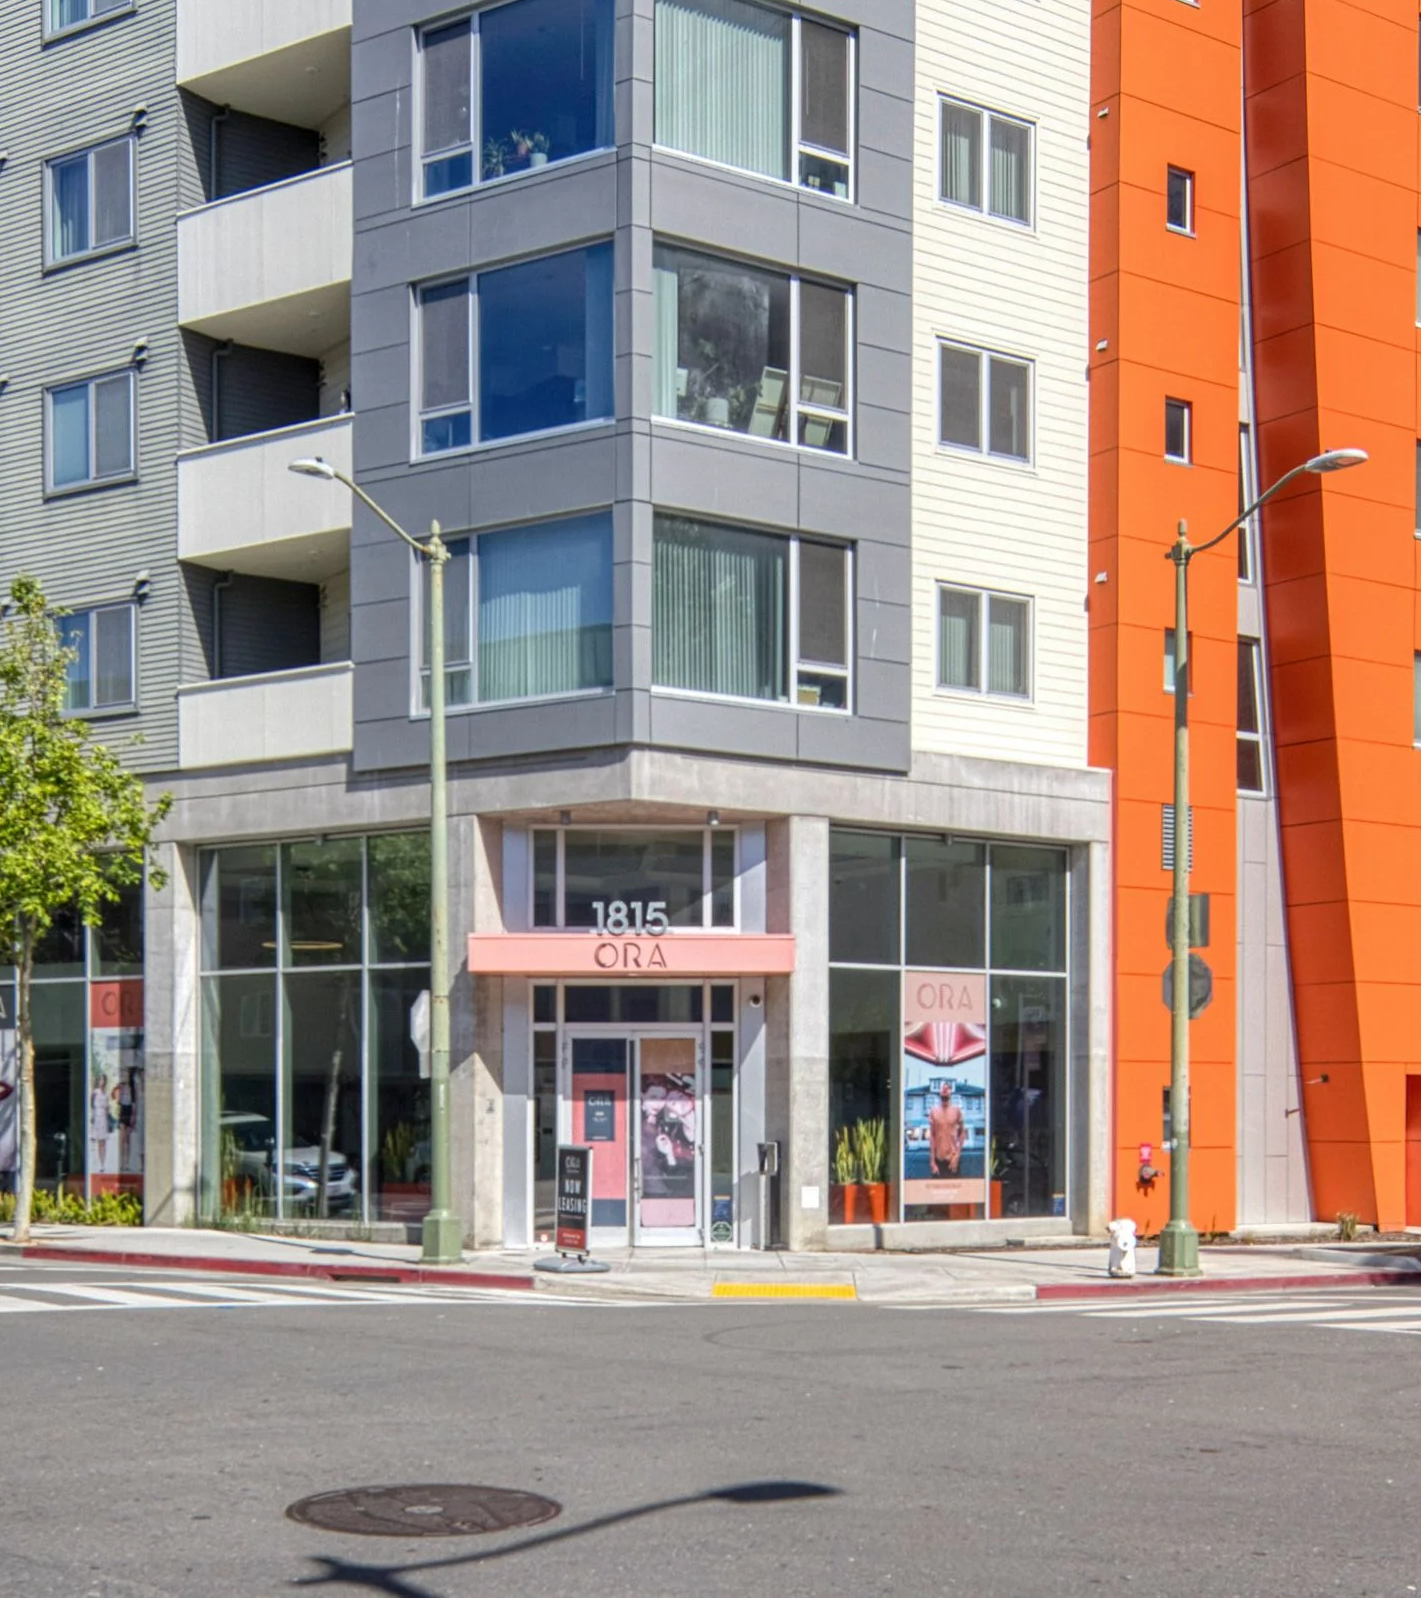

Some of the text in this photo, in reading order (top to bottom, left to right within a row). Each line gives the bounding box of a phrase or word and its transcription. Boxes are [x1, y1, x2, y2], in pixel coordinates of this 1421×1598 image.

[592, 900, 669, 936] 1815
[594, 942, 667, 969] ORA
[101, 990, 143, 1017] OR
[916, 982, 973, 1010] ORA
[564, 1179, 581, 1194] NOW
[558, 1197, 587, 1214] LEASING
